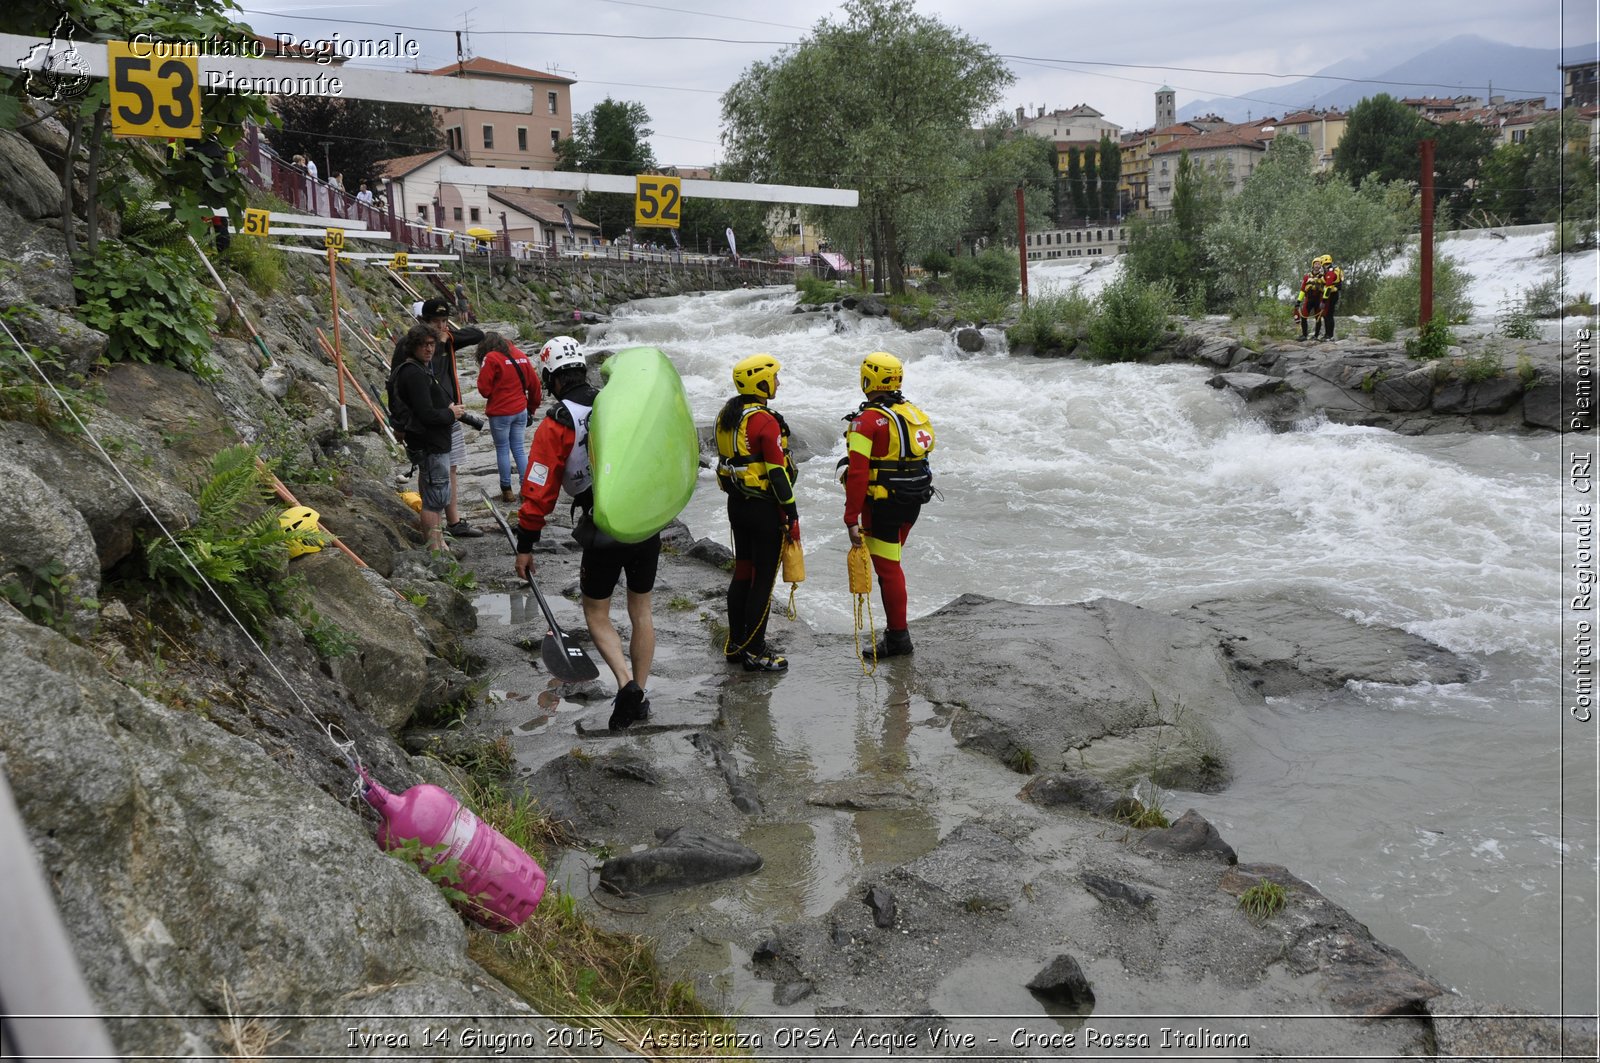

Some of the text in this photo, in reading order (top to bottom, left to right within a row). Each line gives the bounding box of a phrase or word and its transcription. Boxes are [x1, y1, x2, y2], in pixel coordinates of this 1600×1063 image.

[115, 57, 194, 129] 53
[639, 183, 679, 219] 52
[247, 213, 266, 233] 51
[326, 232, 343, 246] 50
[395, 255, 407, 267] 49
